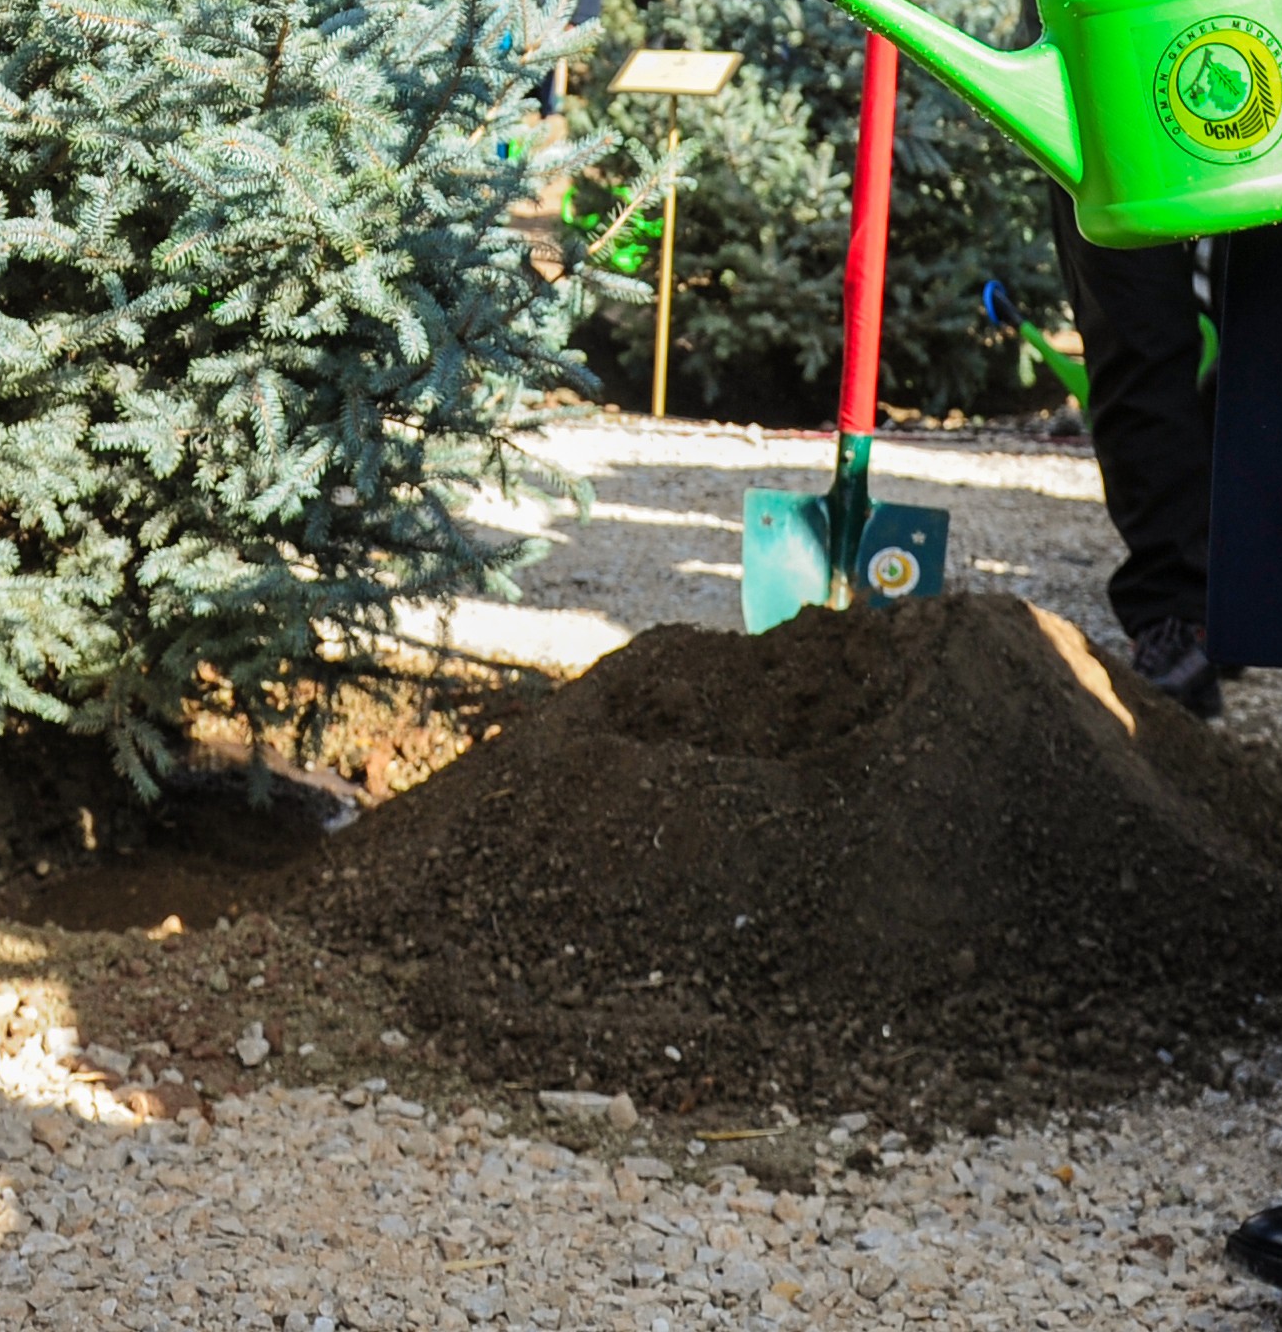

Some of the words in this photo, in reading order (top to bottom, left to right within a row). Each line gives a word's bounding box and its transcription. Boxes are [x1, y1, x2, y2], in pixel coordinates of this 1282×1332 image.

[1168, 22, 1219, 60] GENEL
[1158, 73, 1182, 136] ORMAN
[1203, 121, 1241, 141] OGM
